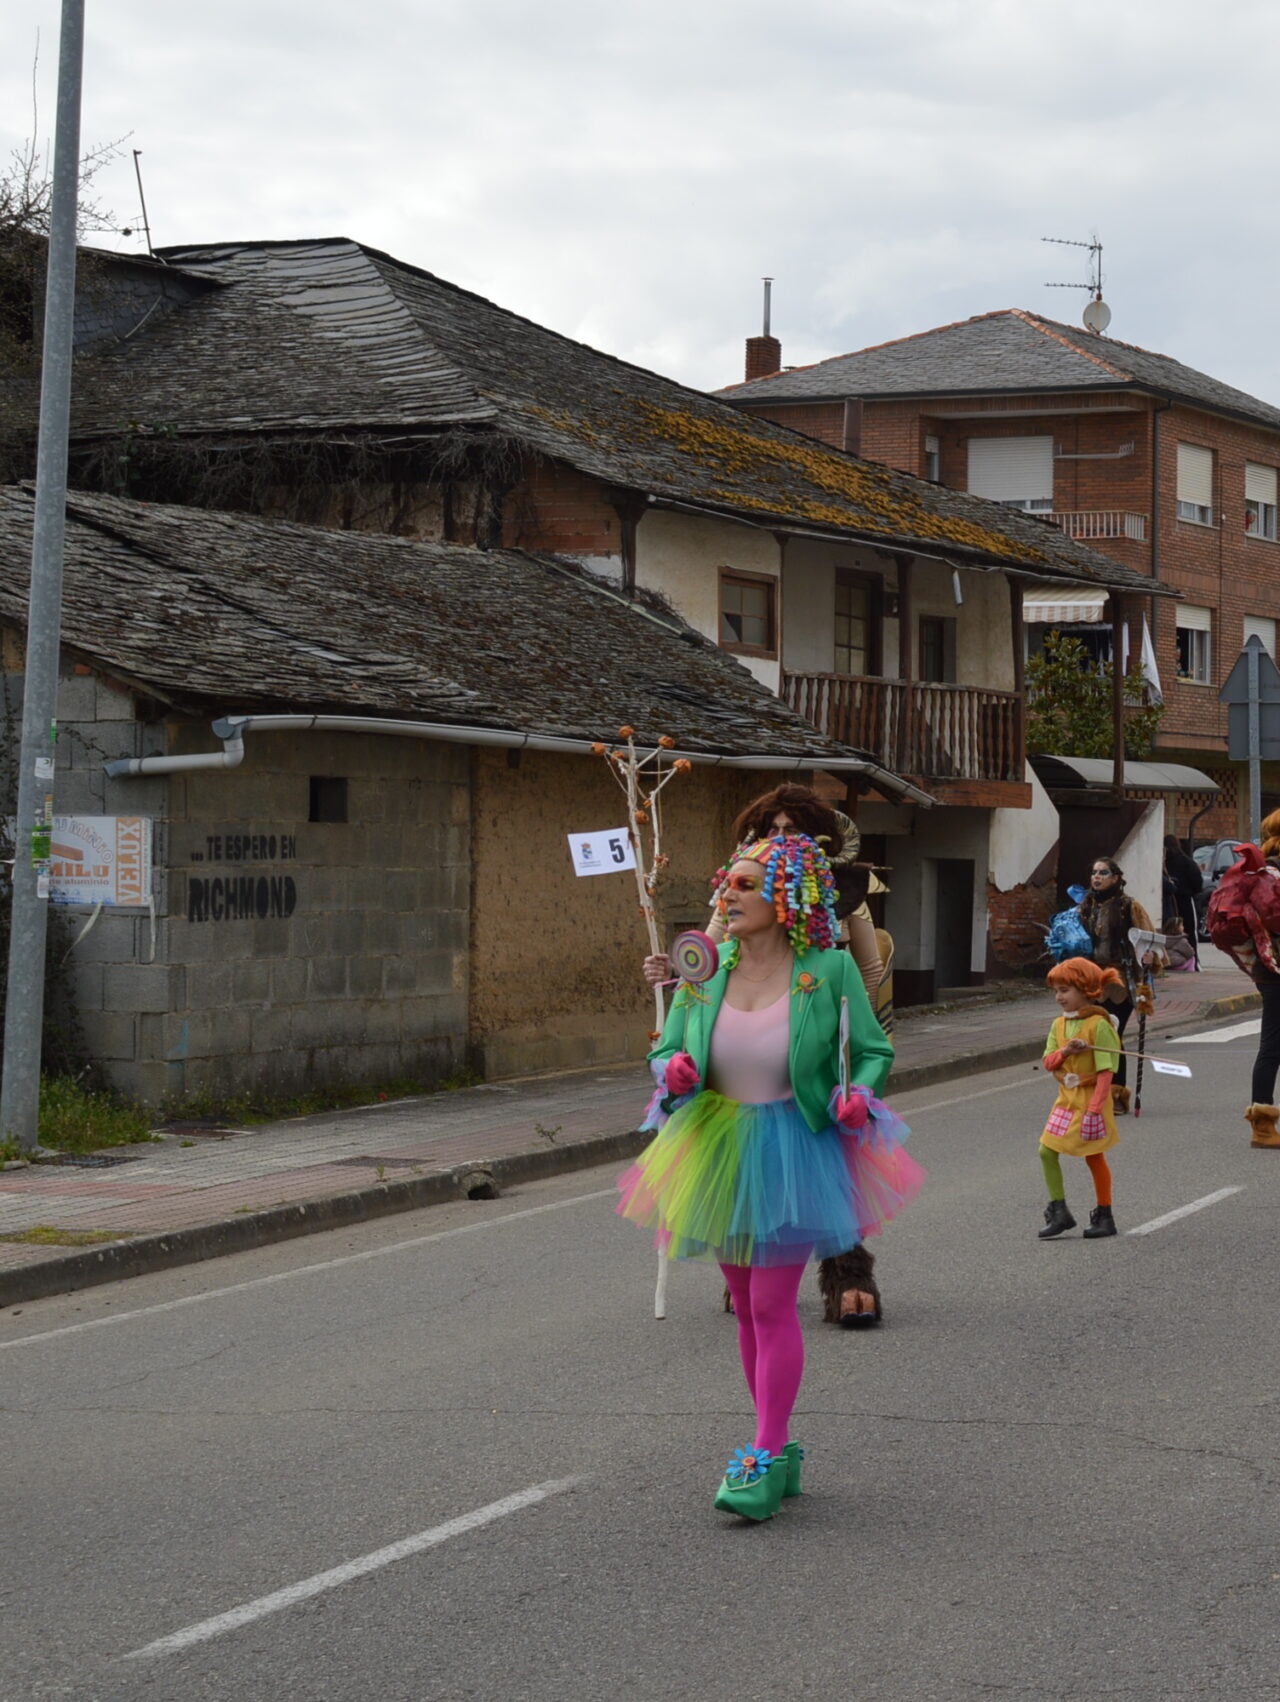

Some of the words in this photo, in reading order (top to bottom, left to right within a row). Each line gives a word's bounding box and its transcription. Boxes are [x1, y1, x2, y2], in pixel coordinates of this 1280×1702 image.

[118, 821, 140, 902] VELUX
[225, 835, 276, 860] ESPERO
[280, 835, 296, 859] EN
[608, 838, 625, 864] 5
[189, 876, 297, 922] RICHMOND
